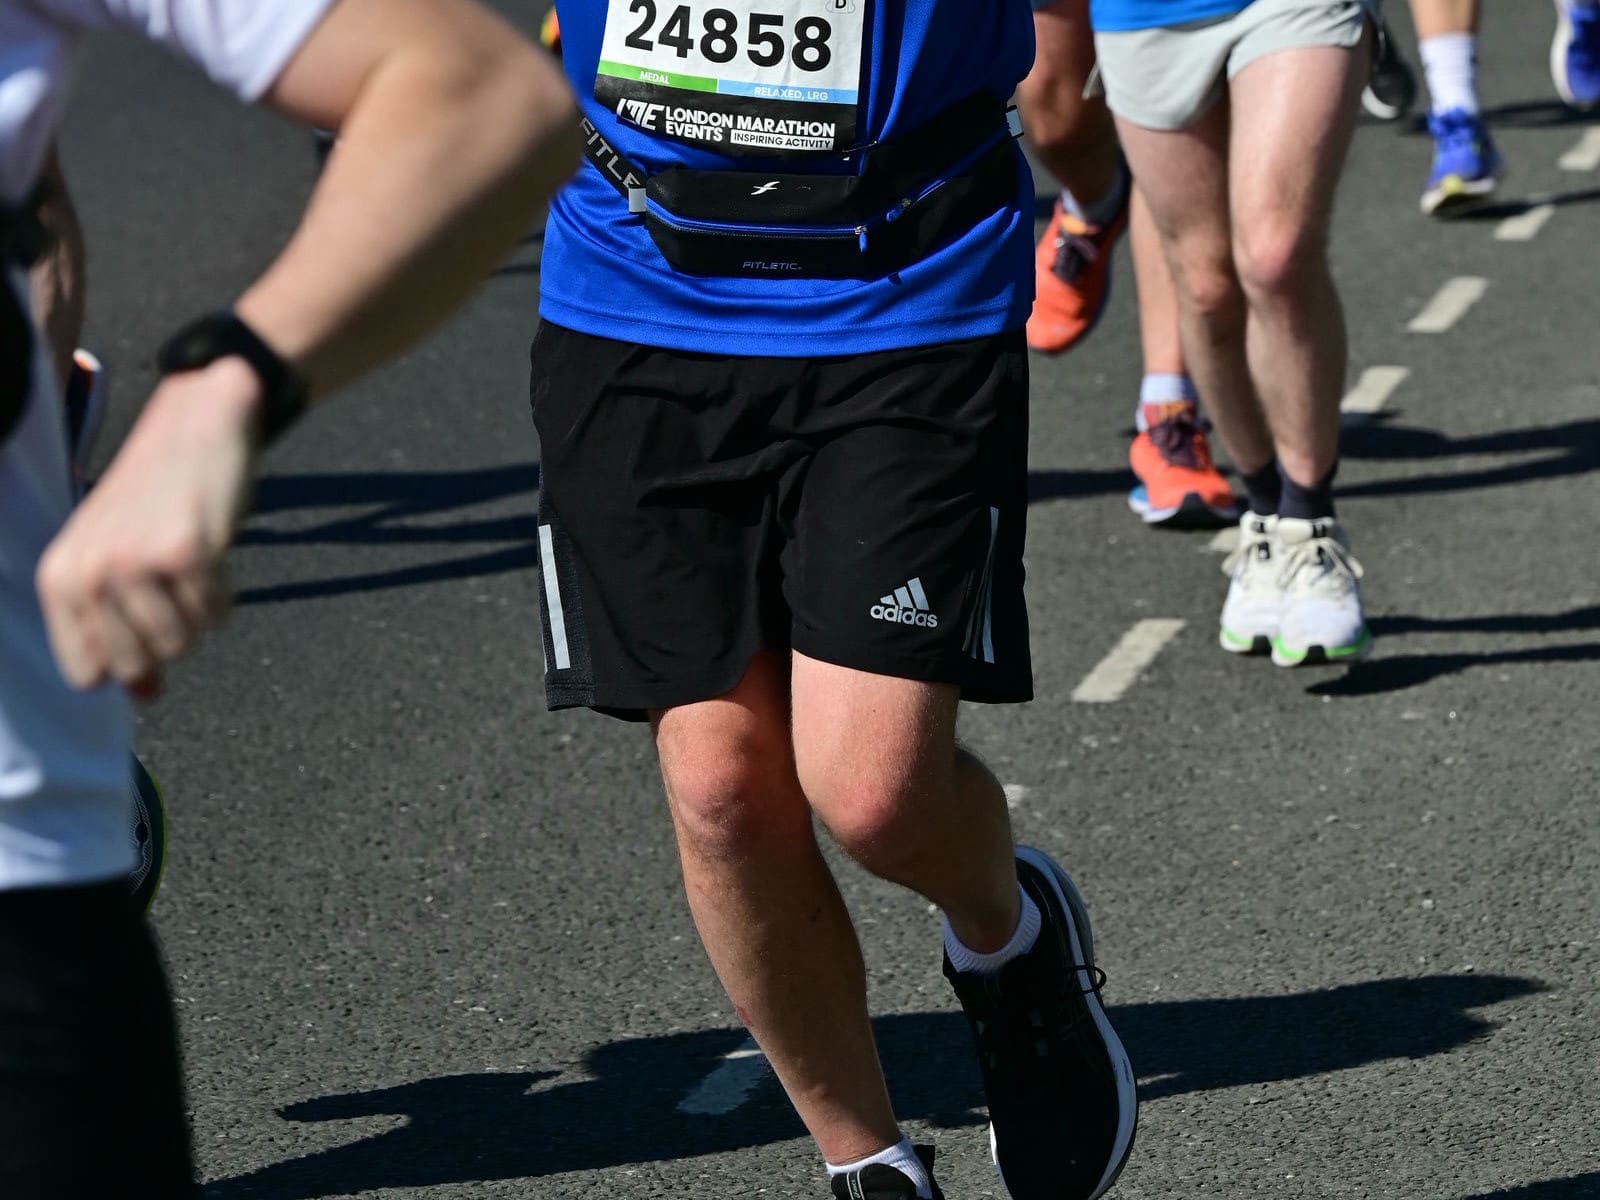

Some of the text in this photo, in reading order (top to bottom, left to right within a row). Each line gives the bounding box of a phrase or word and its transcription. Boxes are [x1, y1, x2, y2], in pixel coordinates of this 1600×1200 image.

[640, 71, 670, 85] MEDAL
[754, 86, 829, 101] RELAXED, LRG
[665, 107, 835, 138] LONDON MARATHON
[665, 123, 724, 142] EVENTS
[733, 132, 832, 149] INSPIRING ACTIVITY
[870, 604, 938, 628] adidas
